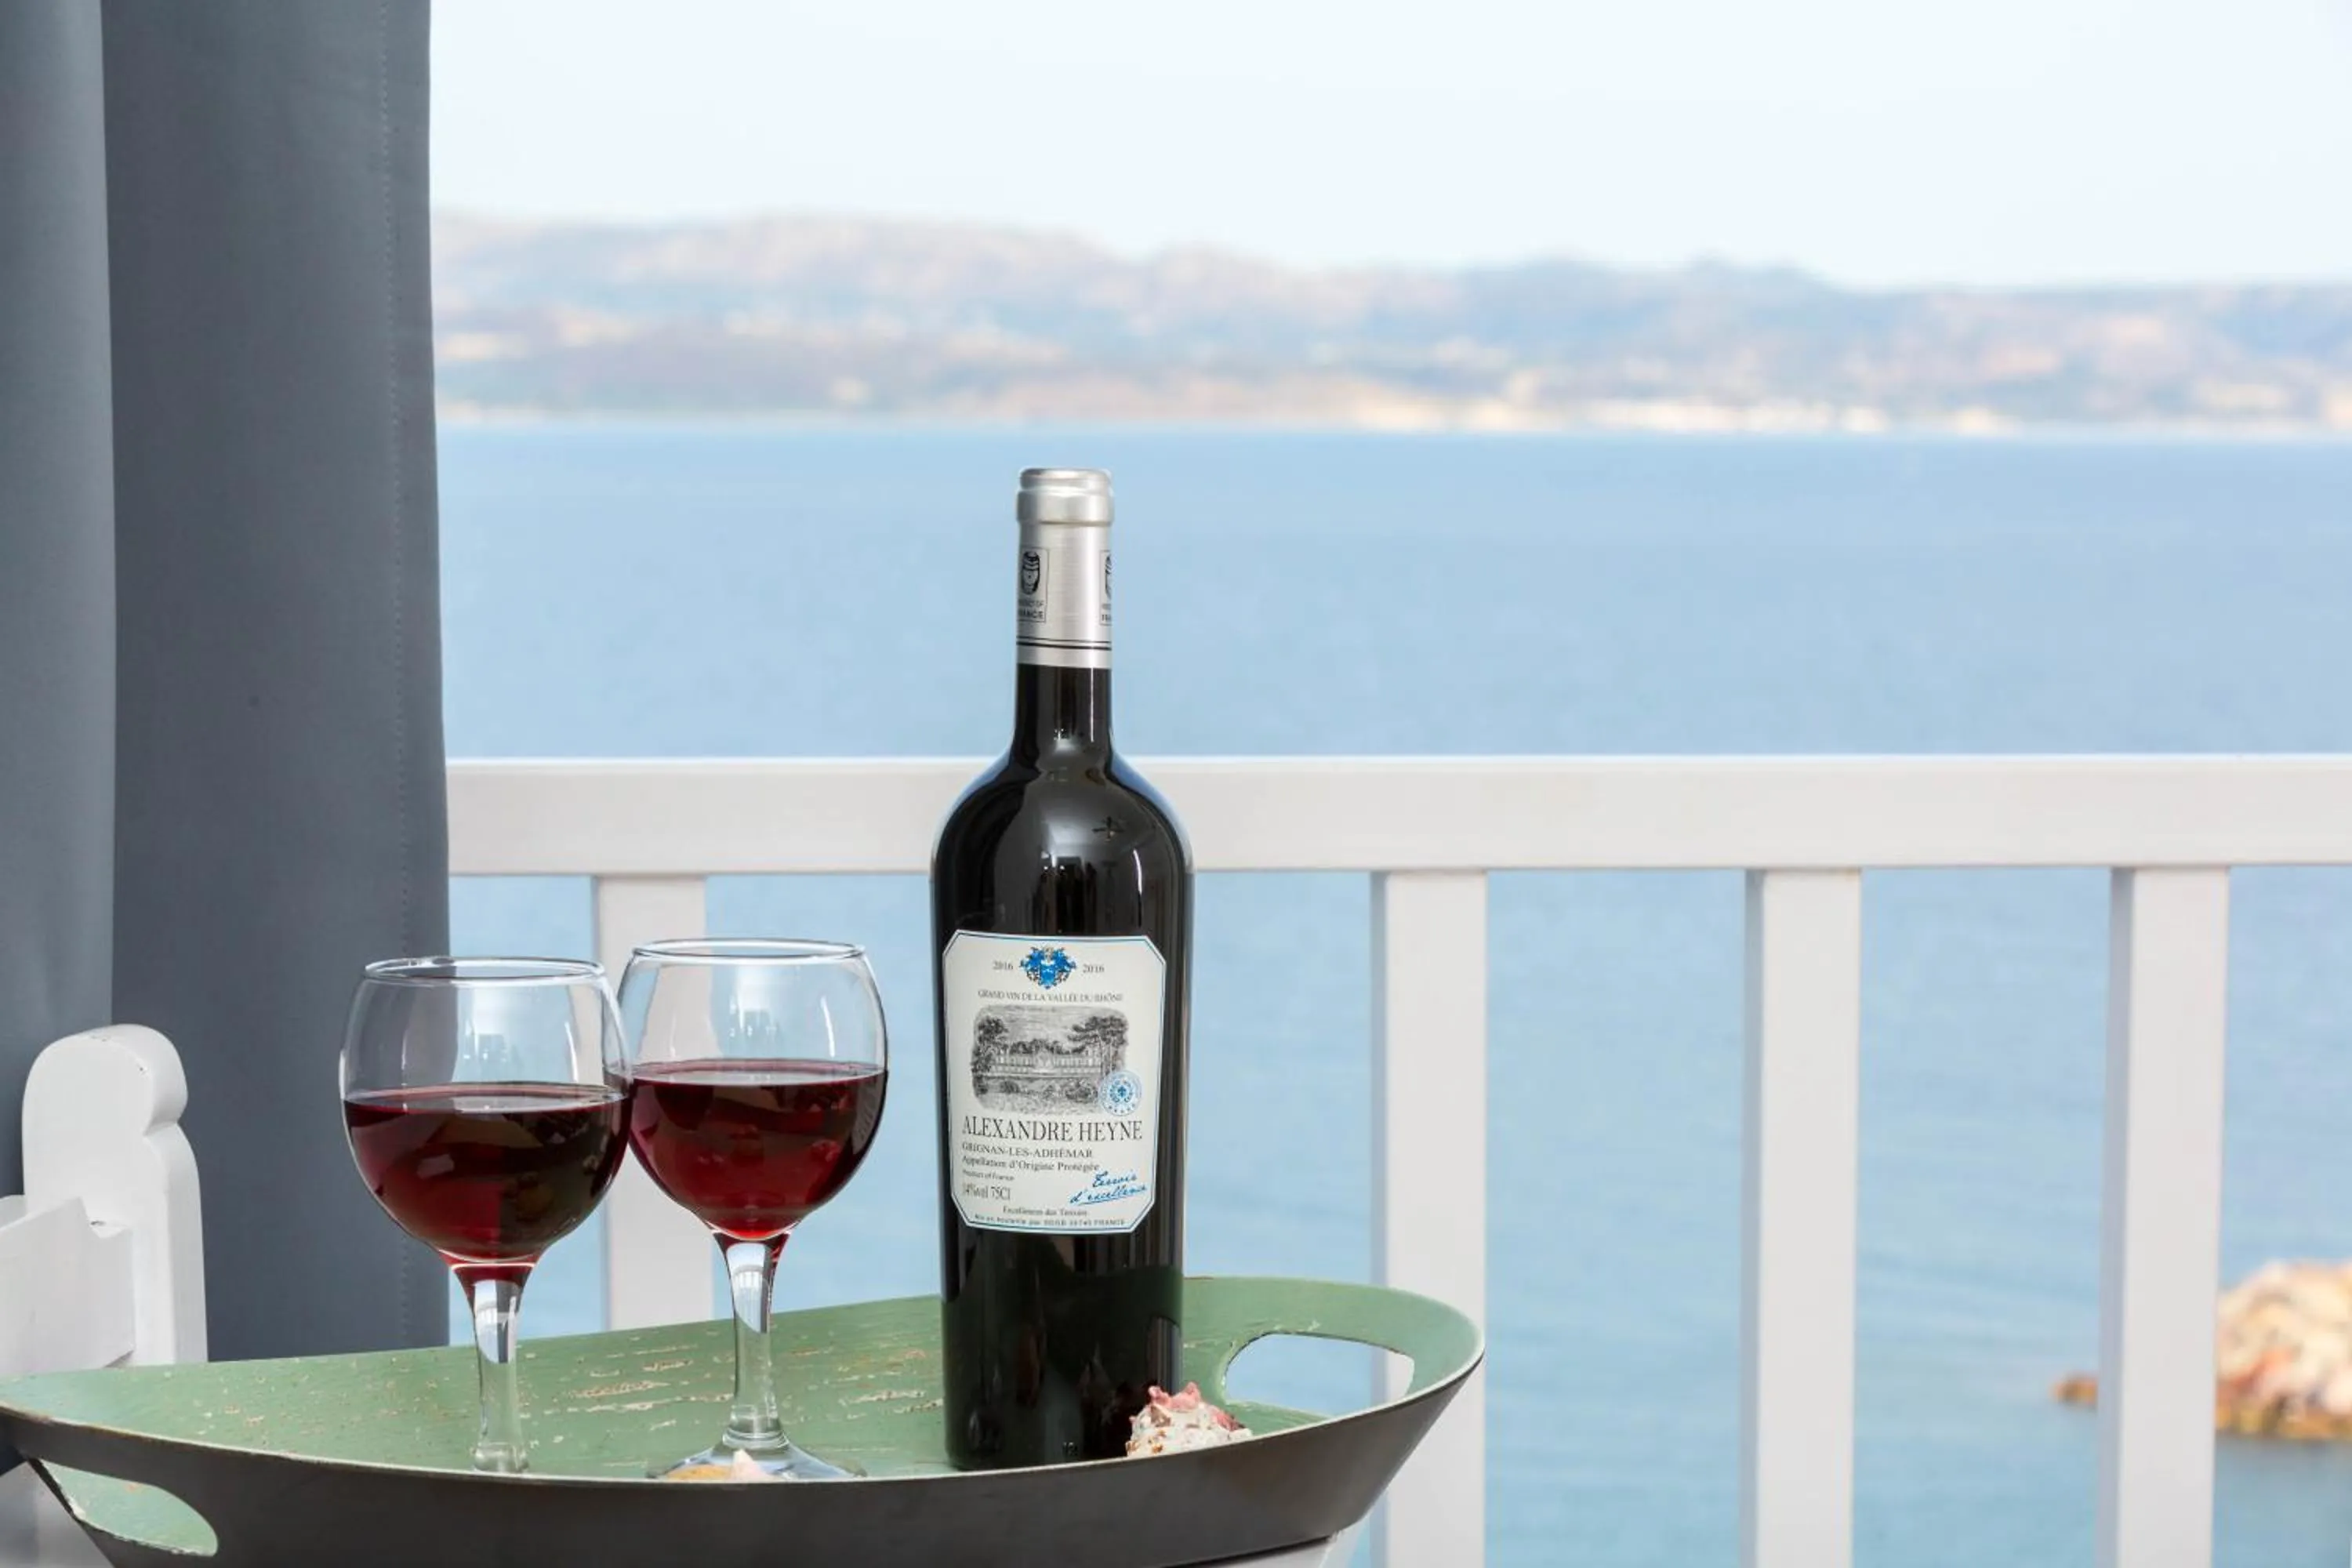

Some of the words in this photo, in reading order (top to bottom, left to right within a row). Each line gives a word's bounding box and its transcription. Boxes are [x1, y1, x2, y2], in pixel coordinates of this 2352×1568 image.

[978, 989, 1004, 1000] GRAND
[1007, 991, 1020, 1000] VIN
[1022, 992, 1034, 1000] DE
[1080, 993, 1091, 1002] DU
[962, 1116, 1074, 1142] ALEXANDRE
[1079, 1120, 1142, 1142] HEYNE
[962, 1156, 1006, 1167] Appellation
[1009, 1160, 1054, 1172] d'Origine
